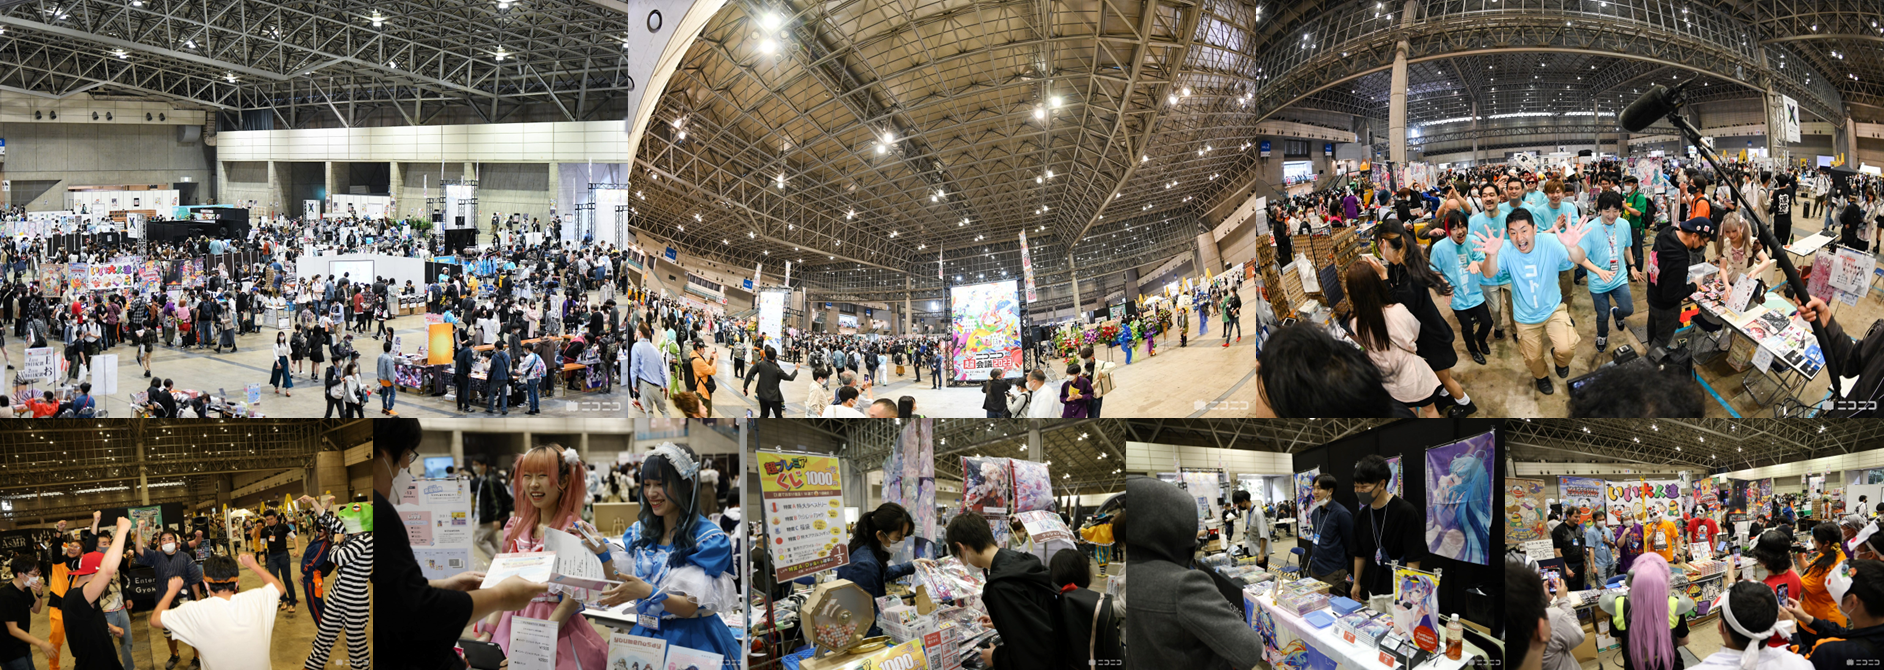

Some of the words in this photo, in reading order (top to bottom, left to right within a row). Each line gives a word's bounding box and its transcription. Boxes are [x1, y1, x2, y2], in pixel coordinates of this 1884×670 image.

[90, 264, 132, 276] いい大人達
[1525, 264, 1539, 308] コトー
[976, 352, 1004, 360] ニコニコ
[44, 366, 52, 376] お
[764, 456, 807, 476] 超プレミア
[776, 470, 804, 490] くじ
[1608, 483, 1680, 502] いい大人達
[614, 637, 661, 649] youmenosay
